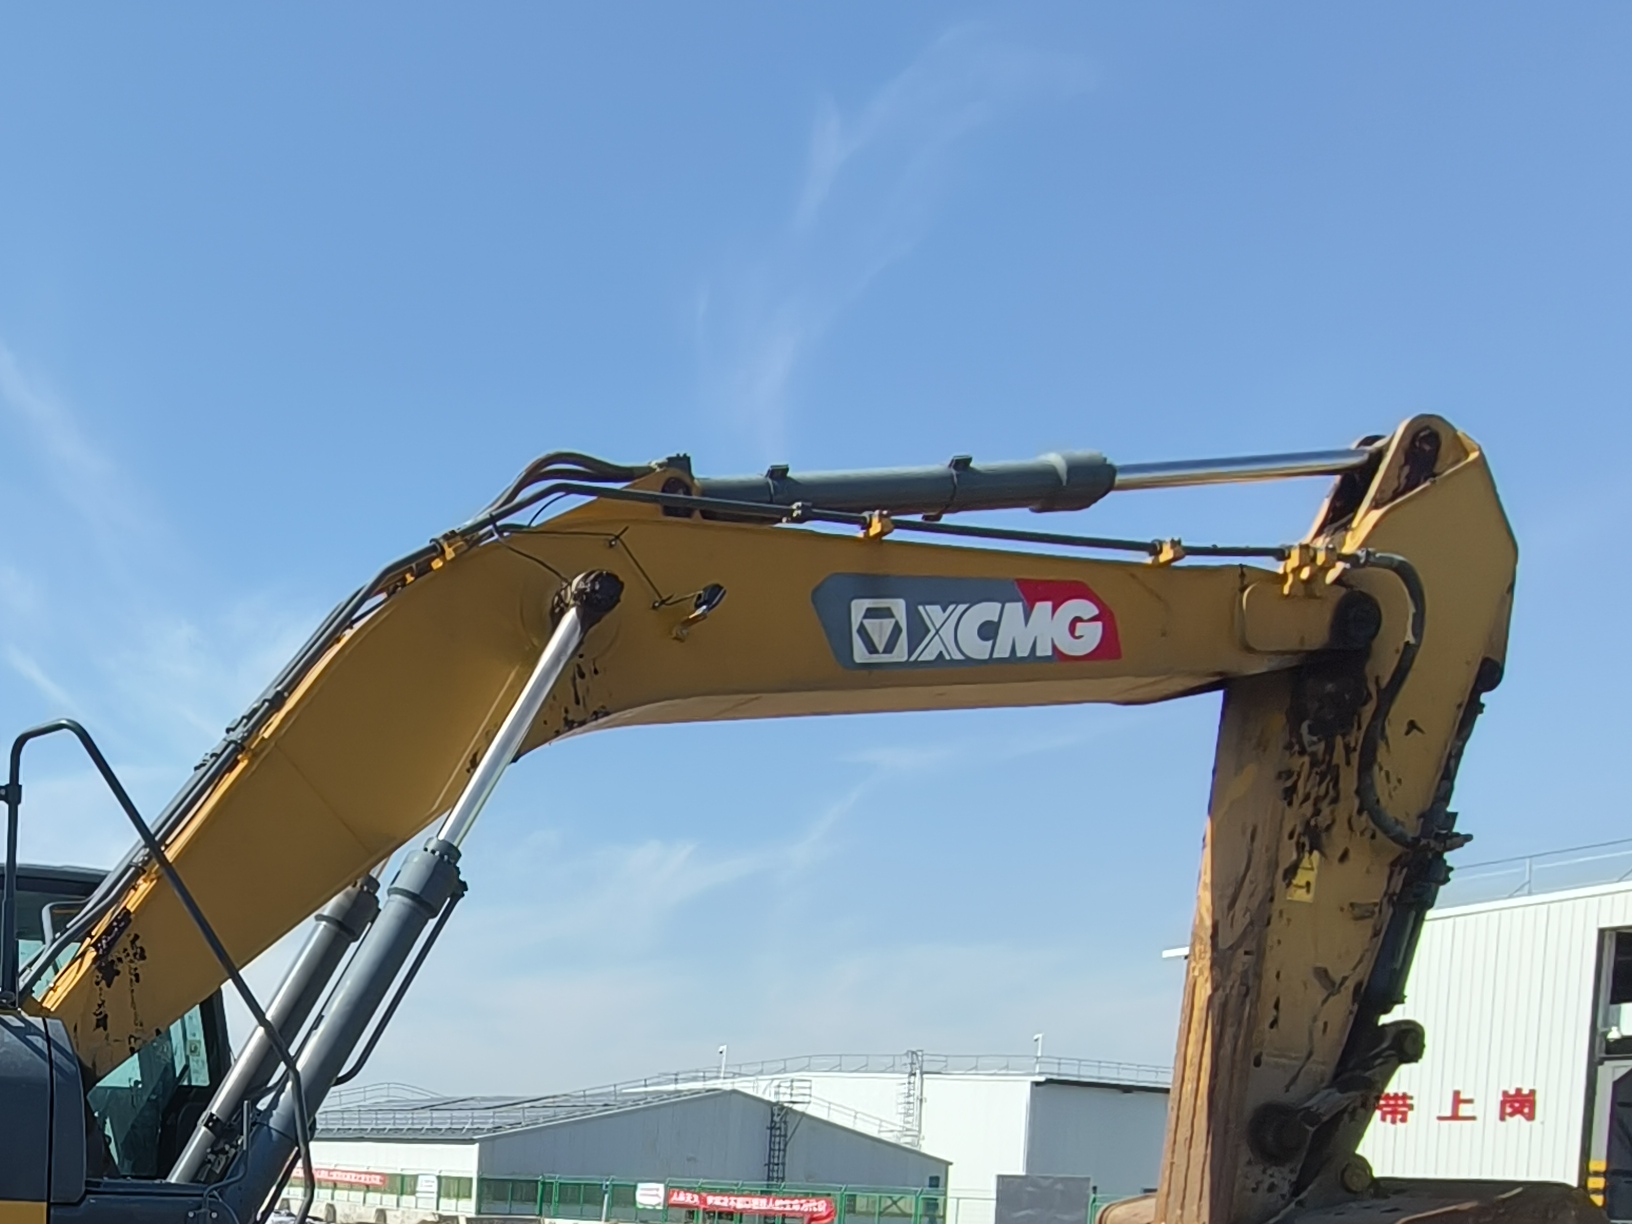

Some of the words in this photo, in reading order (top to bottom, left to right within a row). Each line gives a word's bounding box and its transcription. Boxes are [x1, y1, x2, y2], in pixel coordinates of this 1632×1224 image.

[909, 599, 1103, 661] XCMG
[1376, 1088, 1537, 1124] 带上岗
